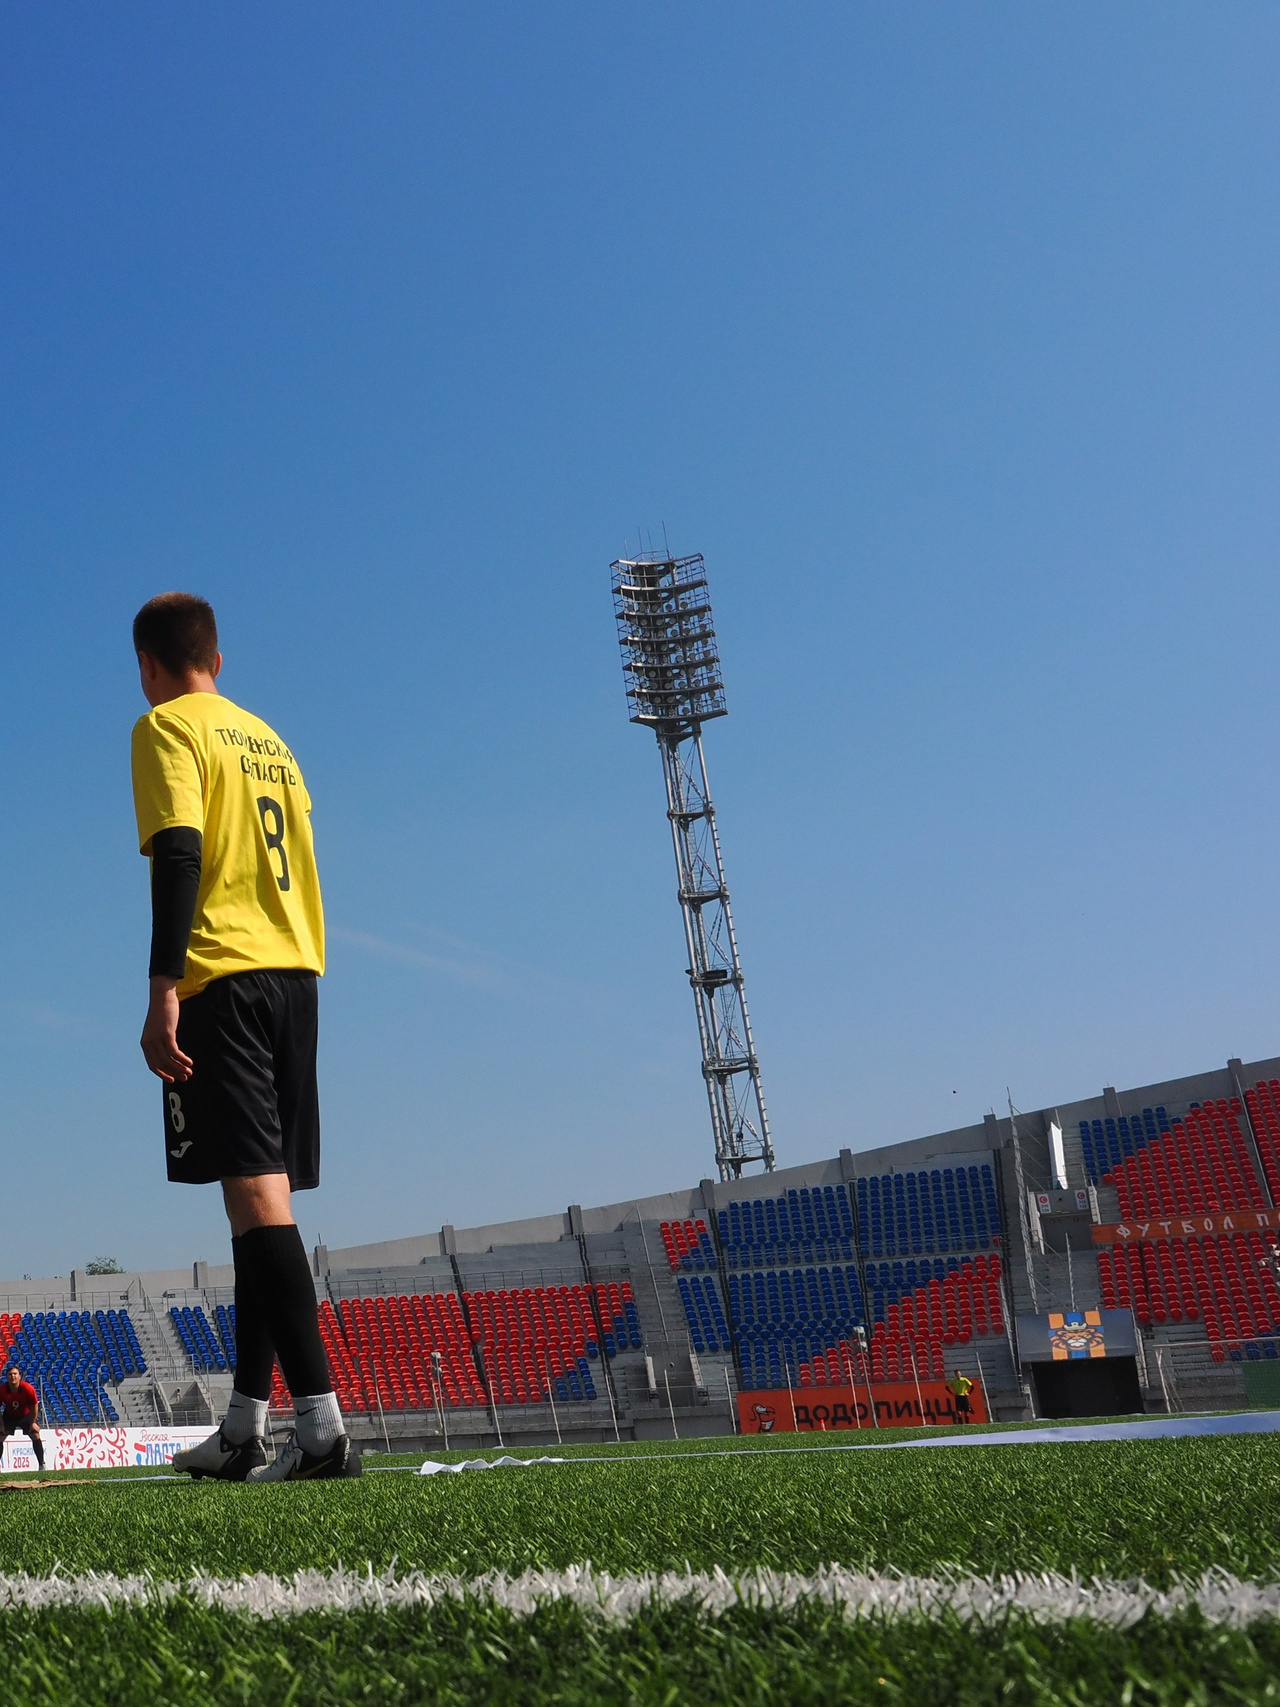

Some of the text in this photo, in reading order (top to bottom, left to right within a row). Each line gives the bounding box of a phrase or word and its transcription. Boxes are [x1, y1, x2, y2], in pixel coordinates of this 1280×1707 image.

[168, 1092, 186, 1133] 8
[1116, 1215, 1234, 1239] ФУТБОЛ
[12, 1400, 20, 1410] 9
[795, 1397, 975, 1428] ДОДО ПИЦЦ
[13, 1456, 30, 1469] 2025
